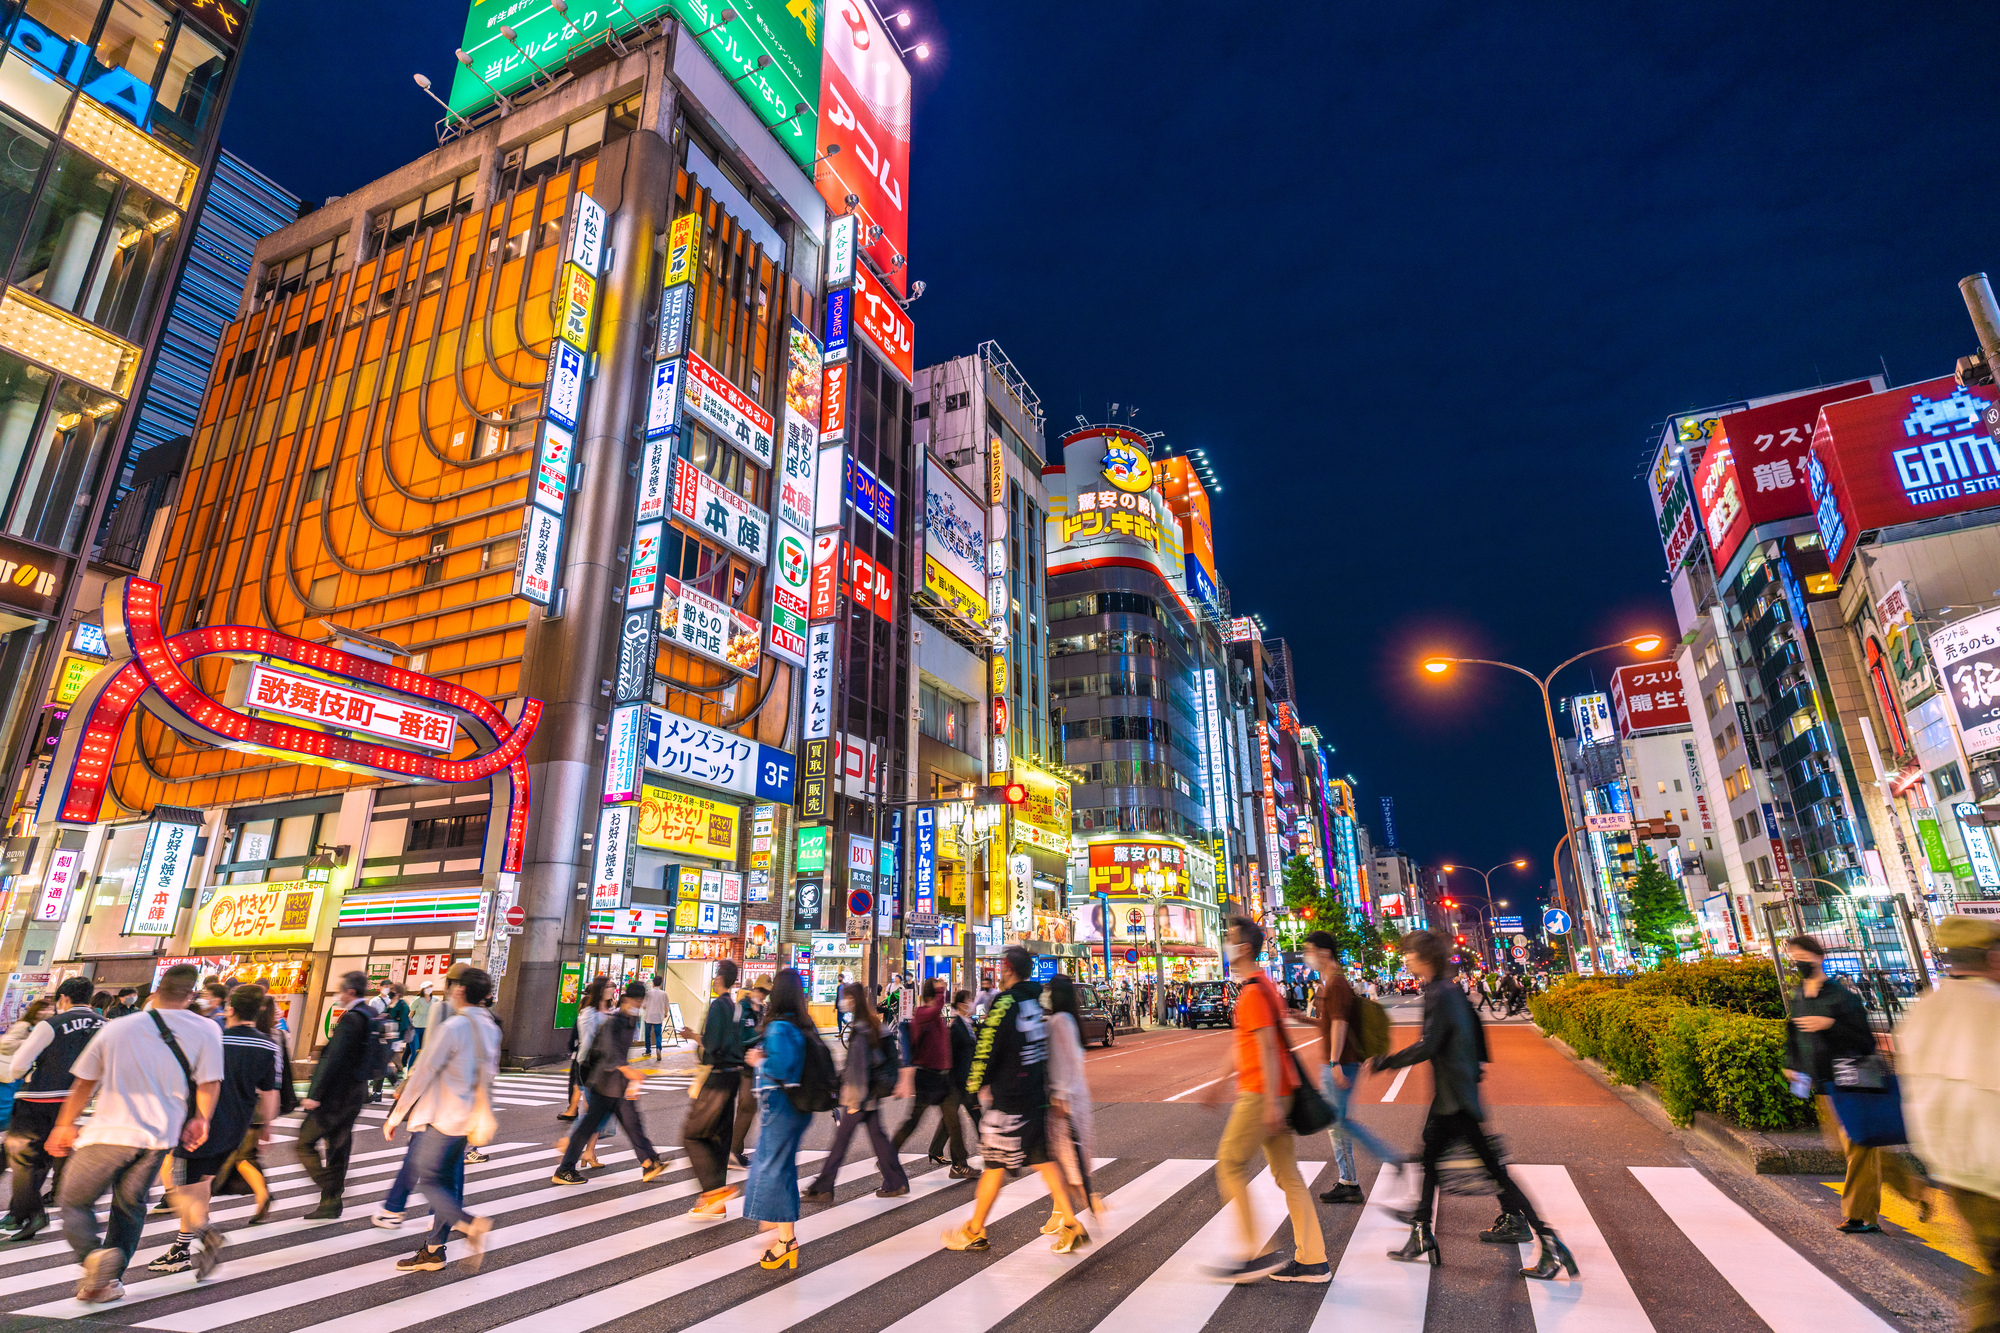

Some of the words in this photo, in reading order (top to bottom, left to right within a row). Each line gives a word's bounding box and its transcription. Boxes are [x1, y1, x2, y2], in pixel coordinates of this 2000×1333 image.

[484, 10, 598, 84] 当ビルとなり
[756, 13, 803, 78] 新生フィナンシャル
[828, 82, 902, 211] アコム
[579, 205, 600, 266] 小松ビル
[669, 218, 691, 274] 麻雀ブル
[833, 223, 849, 275] 戸谷ビル
[670, 271, 683, 282] 6F
[567, 271, 592, 334] 麻雀ブル
[671, 288, 683, 315] BUZZ
[832, 294, 844, 337] PROMISE
[853, 269, 911, 353] アイフル
[567, 329, 582, 344] 6F
[667, 314, 680, 355] STAND
[828, 337, 845, 348] プロミス
[863, 314, 883, 341] 当ビル
[883, 336, 897, 356] 5F
[830, 350, 842, 360] 6F
[688, 358, 769, 429] て食べて楽しめる!!
[826, 380, 841, 431] アイフル
[703, 394, 736, 423] お好み焼き
[735, 418, 771, 458] 本陣
[785, 421, 801, 479] 専門店
[799, 422, 813, 478] 粉もの
[826, 432, 838, 441] 5F
[648, 443, 663, 499] お好み焼き
[542, 484, 560, 500] ATM
[640, 497, 662, 511] 本陣
[781, 482, 812, 518] 本陣
[1905, 483, 1961, 505] TAITO
[640, 509, 660, 518] HONJIN
[704, 496, 762, 554] 本陣
[782, 503, 810, 532] HONJIN
[534, 515, 552, 576] お好み焼き
[525, 585, 547, 601] HONJIN
[526, 573, 549, 592] 本陣
[633, 584, 650, 594] ATM
[817, 565, 831, 605] アコム
[855, 588, 867, 603] 5F
[777, 589, 806, 616] たばこ
[816, 606, 829, 616] 3F
[683, 602, 722, 634] 粉もの
[783, 612, 797, 631] 酒
[681, 623, 721, 655] 専門店
[773, 629, 804, 656] ATM
[1933, 625, 1969, 648] ブランド品
[1943, 633, 1995, 661] 売るのも
[256, 672, 448, 744] 歌舞伎町一番街
[663, 719, 751, 762] メンズライフ
[1259, 724, 1270, 763] カラオケ
[615, 722, 629, 791] ファイトフィット
[661, 746, 735, 784] クリニック
[763, 760, 790, 789] 3F
[809, 744, 823, 773] 買取
[1684, 742, 1702, 792] 新宿サンパーク
[807, 782, 821, 812] 販売
[1263, 772, 1275, 808] パセラ
[662, 801, 704, 826] やきとり
[710, 815, 732, 831] やきとり
[604, 812, 621, 881] お好み焼き
[661, 820, 704, 845] センター
[709, 827, 730, 842] 専門店
[800, 836, 824, 848] レイク
[157, 826, 184, 888] お好み焼き
[799, 849, 824, 859] ALSA
[852, 845, 874, 866] BUY
[1113, 845, 1181, 864] 驚安の殿堂
[45, 855, 72, 914] 劇場通り
[595, 882, 619, 897] 本陣
[147, 890, 170, 921] 本陣
[237, 892, 280, 915] やきとり
[286, 894, 311, 909] やきとり
[595, 898, 616, 908] HONJIN
[138, 922, 169, 932] HONJIN
[233, 915, 276, 937] センター
[285, 909, 306, 924] 専門店
